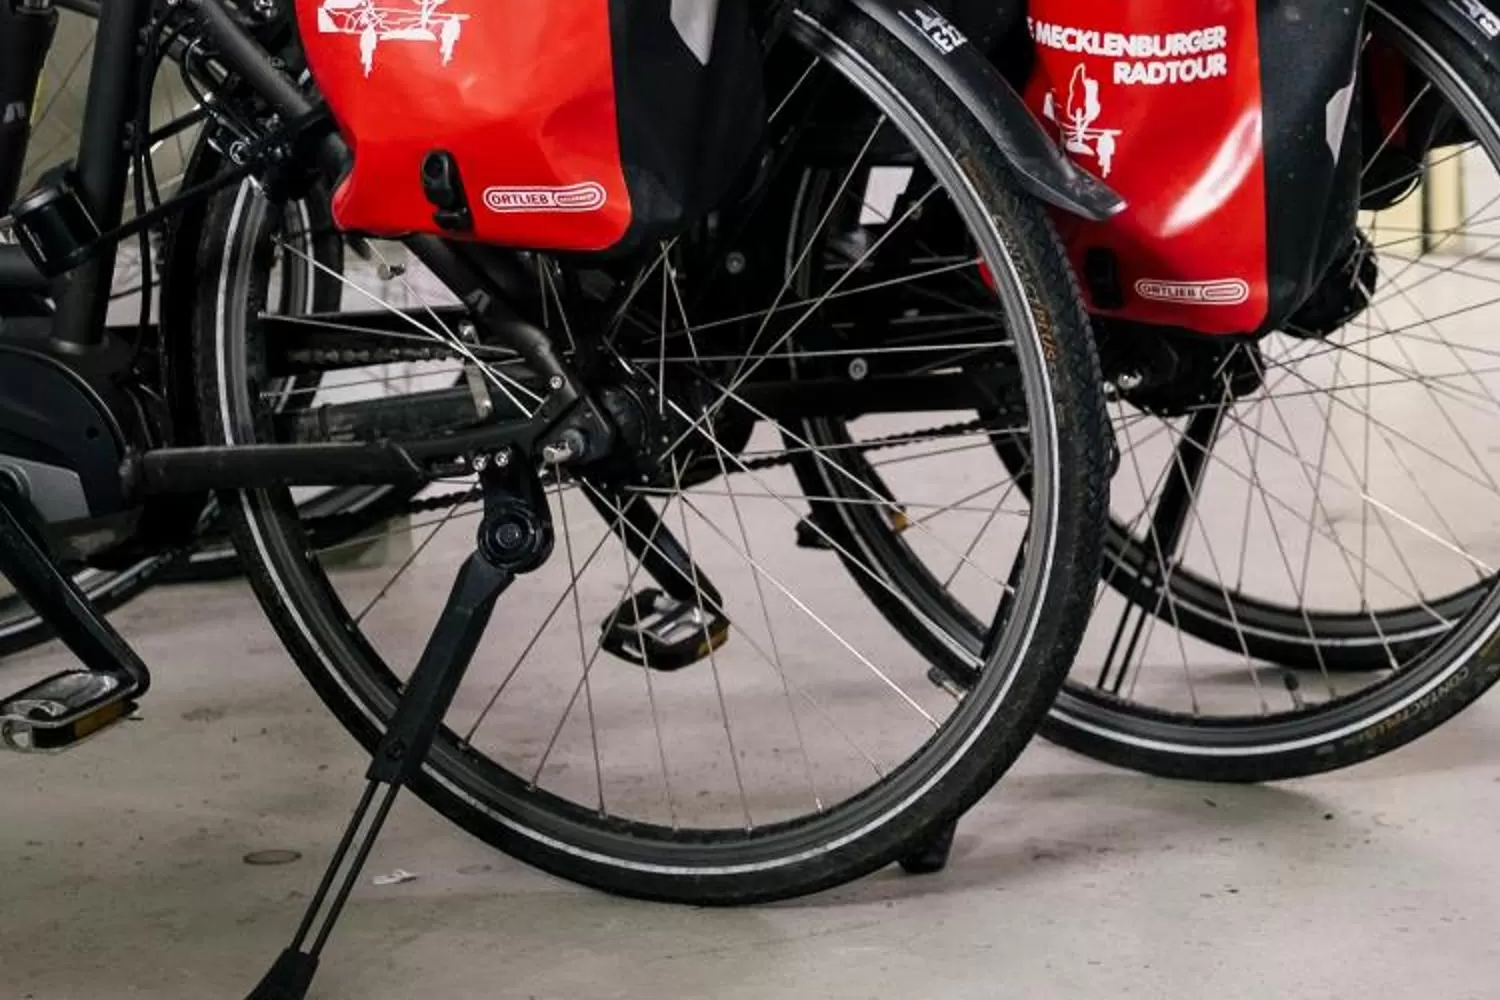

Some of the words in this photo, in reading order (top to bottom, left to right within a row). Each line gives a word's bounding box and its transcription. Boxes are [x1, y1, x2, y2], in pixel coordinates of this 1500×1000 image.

[1035, 20, 1227, 58] MECKLENBURGER
[1113, 52, 1227, 85] RADTOUR
[491, 193, 549, 205] ORTLIEB
